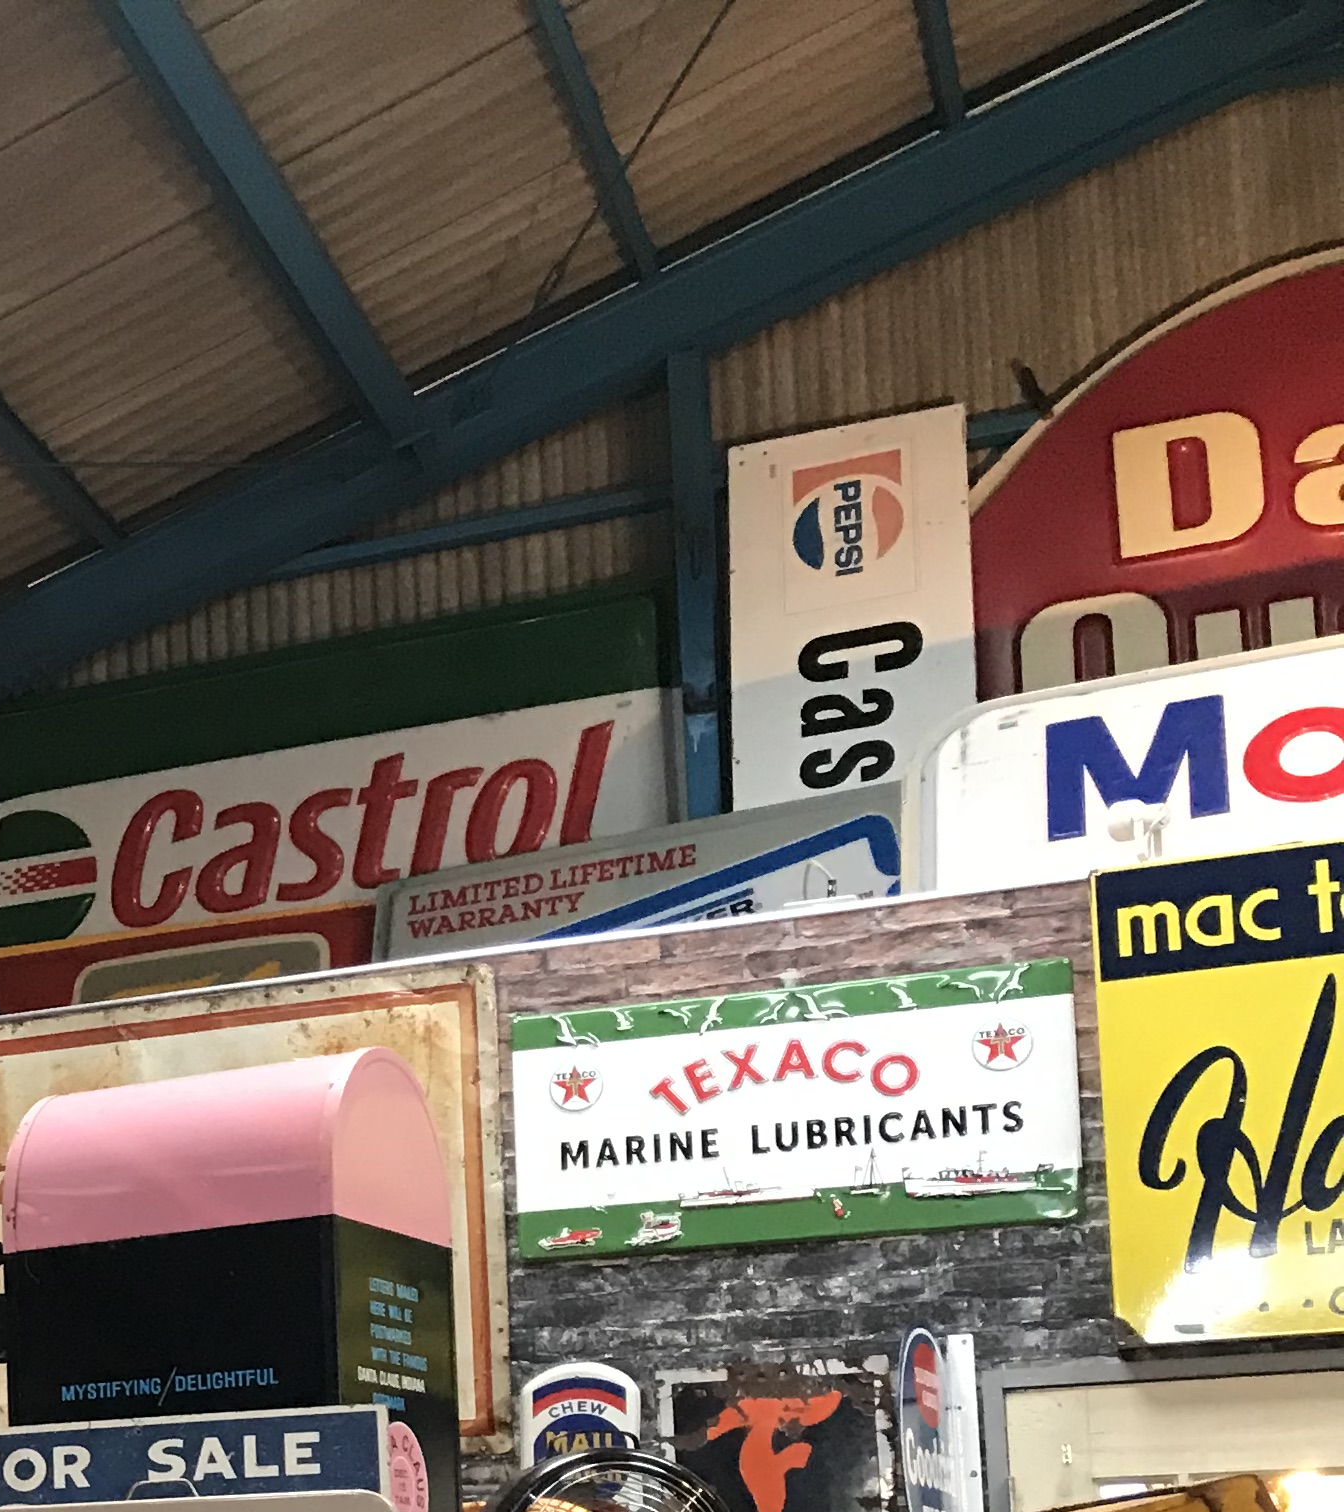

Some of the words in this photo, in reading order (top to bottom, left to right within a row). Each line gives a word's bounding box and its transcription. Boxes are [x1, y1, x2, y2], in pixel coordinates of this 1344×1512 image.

[833, 479, 864, 577] PEPSI
[111, 719, 616, 929] Castrol
[407, 891, 584, 938] WARRANTY
[408, 868, 546, 916] LIMITED
[550, 843, 698, 892] LIFETIME
[1117, 887, 1282, 958] mac
[649, 1038, 920, 1116] TEXACO
[561, 1128, 720, 1171] MARINE
[751, 1101, 1025, 1155] LUBRICANTS
[548, 1401, 608, 1418] CHEW
[147, 1431, 321, 1482] SALE
